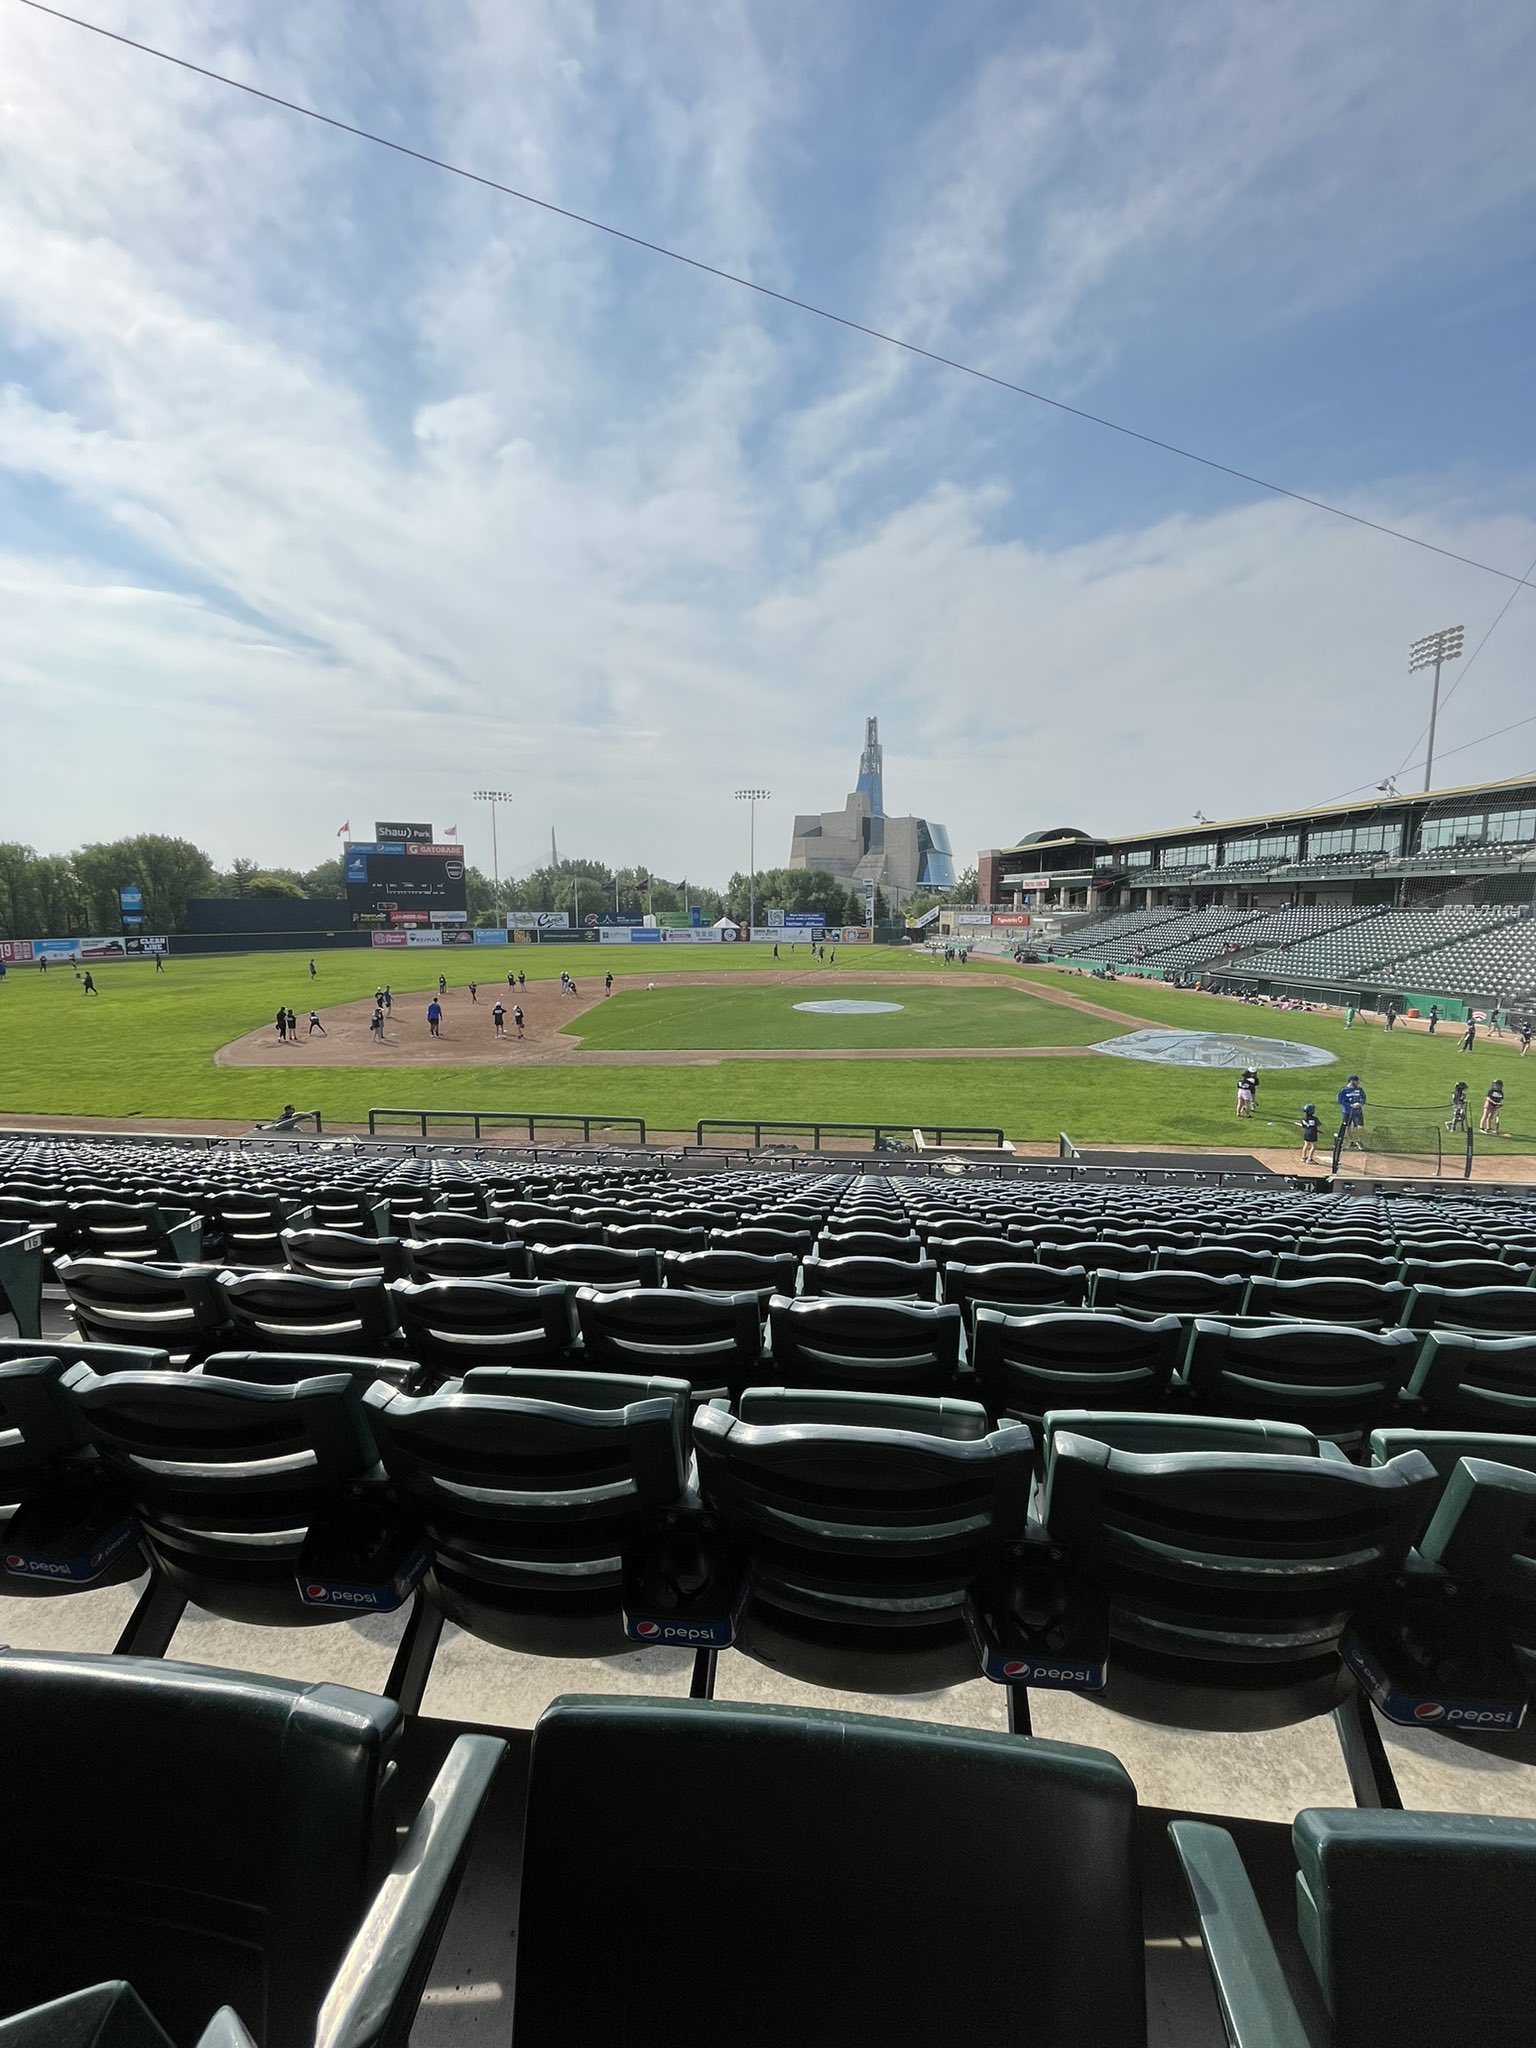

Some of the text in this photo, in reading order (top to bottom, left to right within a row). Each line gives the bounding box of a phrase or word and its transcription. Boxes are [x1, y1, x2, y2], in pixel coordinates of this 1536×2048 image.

[379, 827, 408, 838] Shaw
[420, 845, 461, 854] GATORADE
[28, 1238, 38, 1249] 16
[103, 1529, 132, 1556] pepsi
[29, 1560, 72, 1575] pepsi
[332, 1590, 378, 1604] pepsi
[664, 1627, 714, 1640] pepsi
[1033, 1667, 1091, 1681] pepsi
[1447, 1708, 1513, 1723] pepsi
